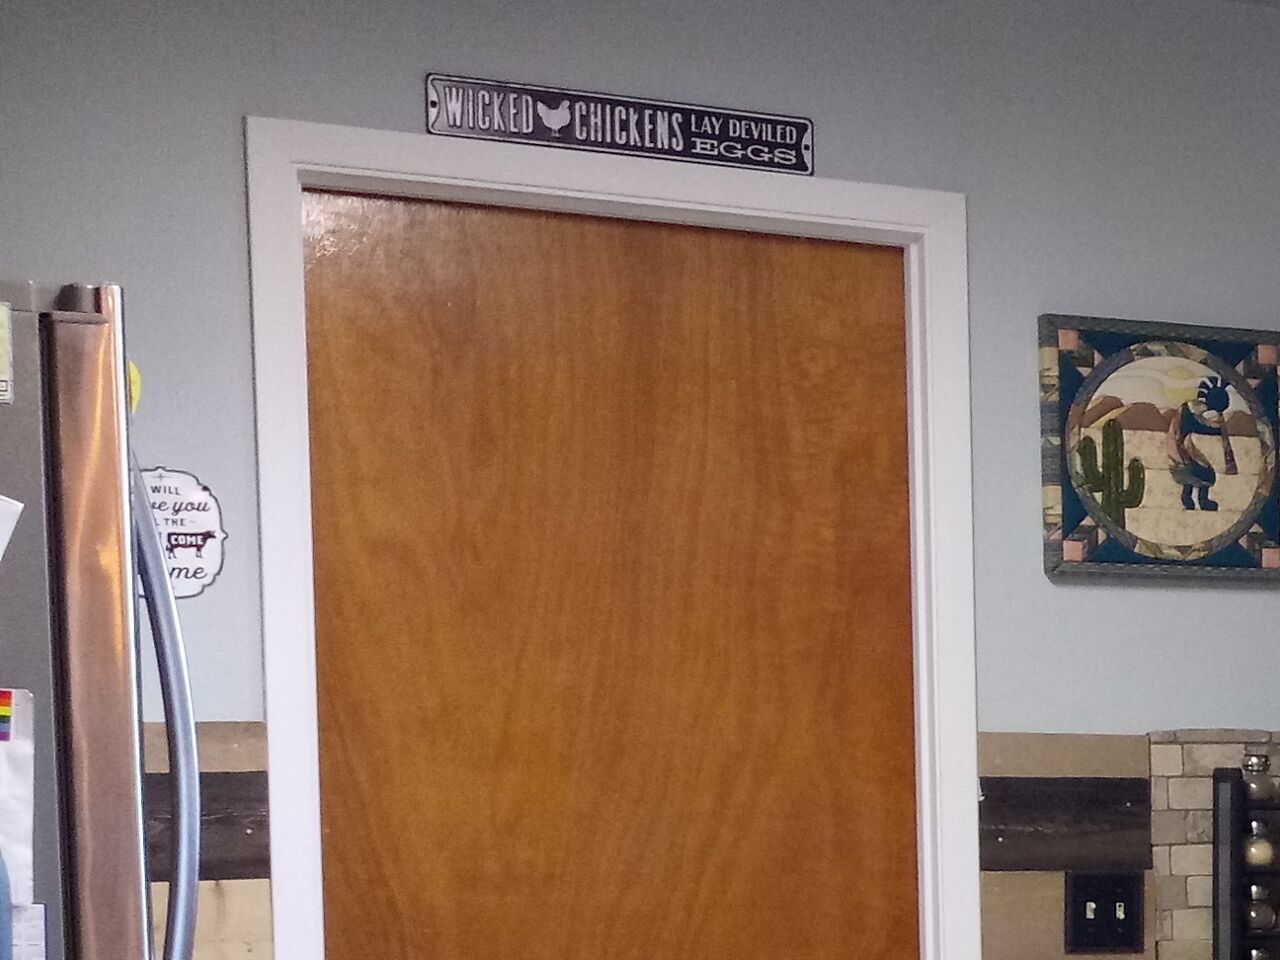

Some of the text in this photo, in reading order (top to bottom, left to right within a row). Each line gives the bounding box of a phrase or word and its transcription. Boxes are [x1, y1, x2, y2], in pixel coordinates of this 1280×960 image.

[443, 86, 684, 152] WICKED CHICKENS
[690, 113, 797, 145] LAY DEVILED
[690, 137, 798, 166] EGGS
[150, 485, 182, 496] WILL
[172, 500, 211, 517] you
[163, 518, 186, 527] THE
[170, 534, 206, 546] COME
[170, 565, 208, 580] me
